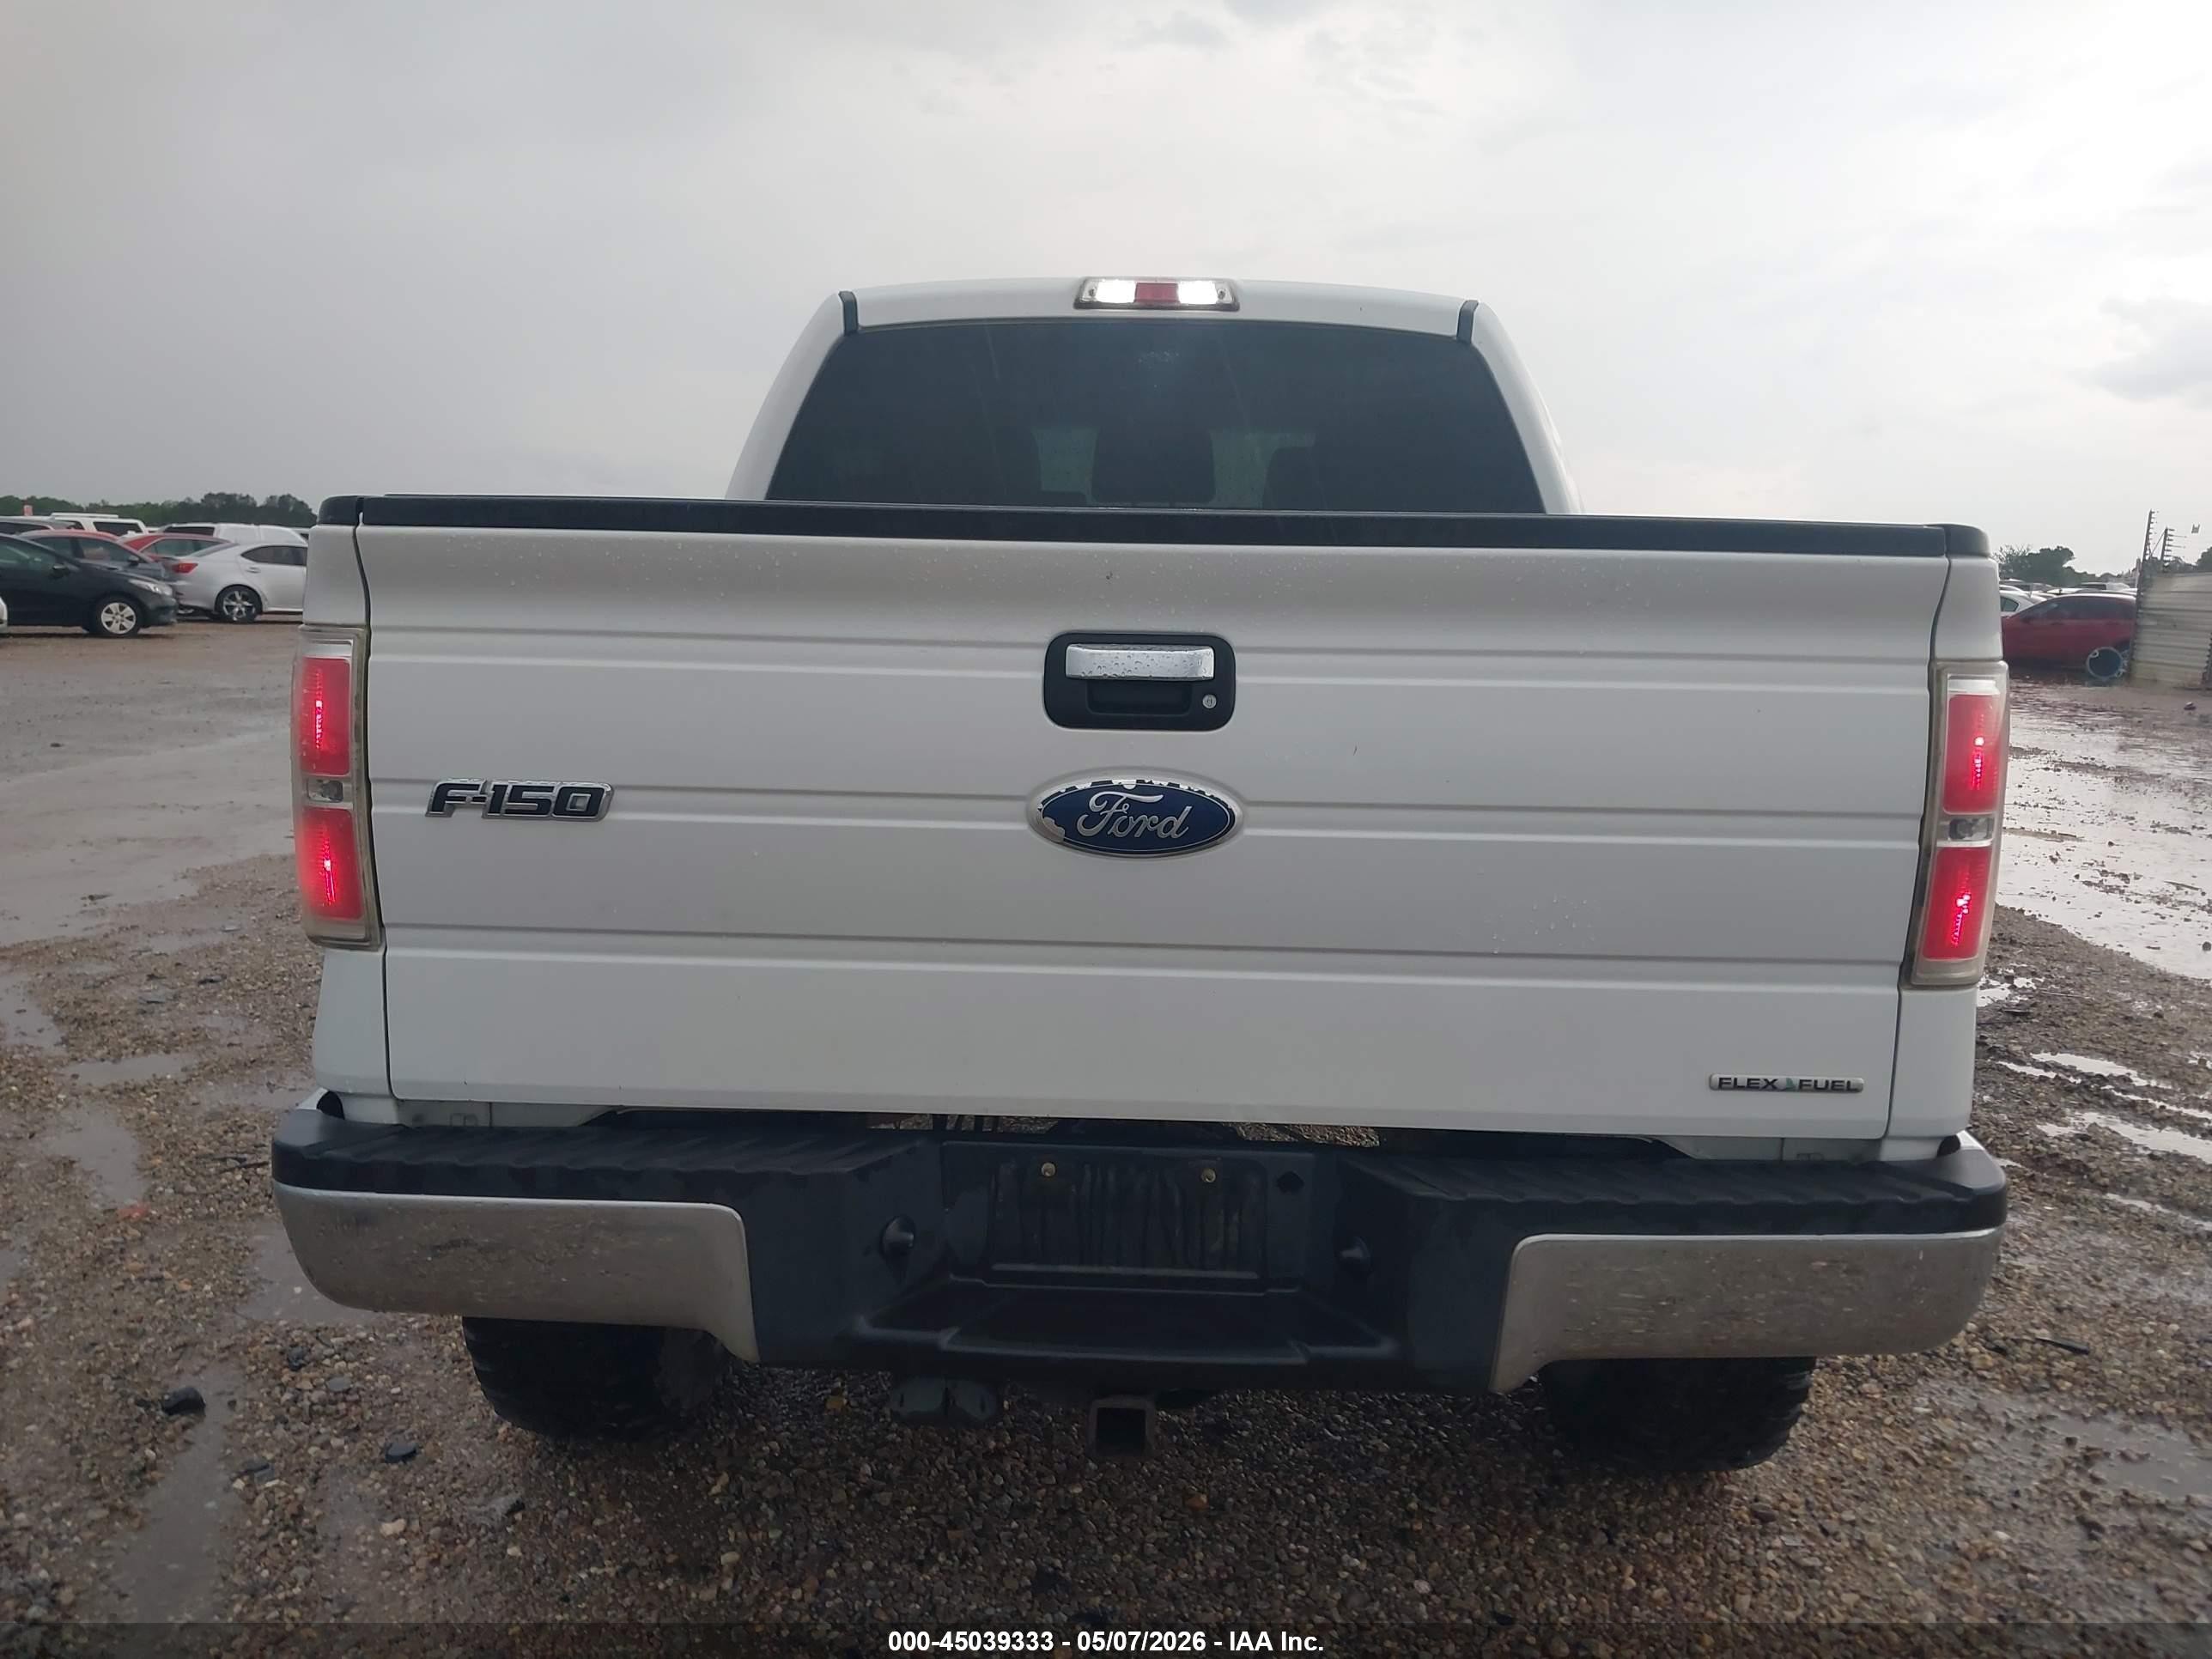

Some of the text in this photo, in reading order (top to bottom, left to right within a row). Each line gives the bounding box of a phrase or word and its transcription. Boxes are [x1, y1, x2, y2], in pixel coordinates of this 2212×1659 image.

[426, 779, 614, 821] F-150
[1077, 791, 1192, 839] Ford
[1718, 1077, 1859, 1091] FLEX FUEL
